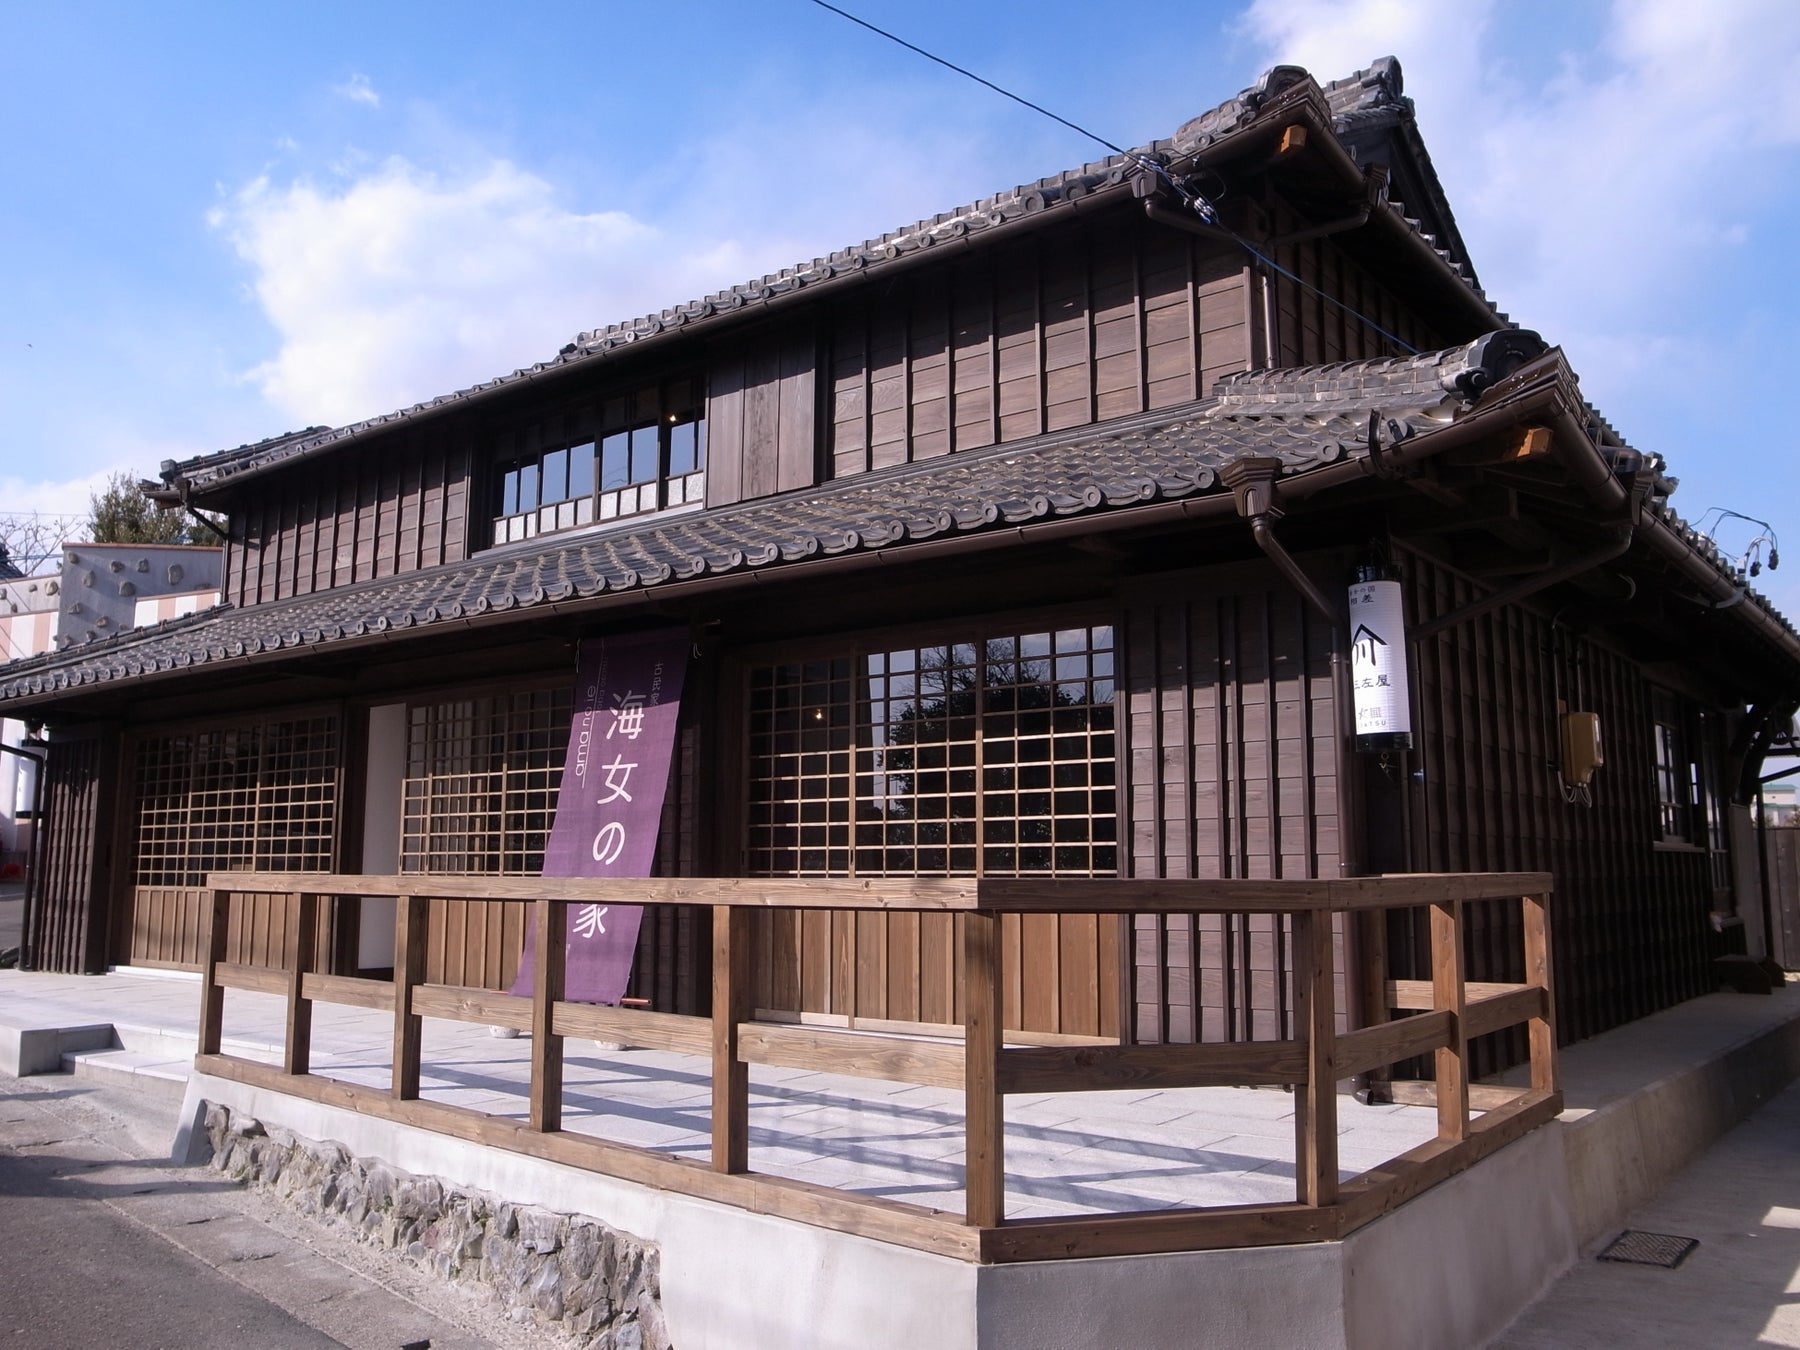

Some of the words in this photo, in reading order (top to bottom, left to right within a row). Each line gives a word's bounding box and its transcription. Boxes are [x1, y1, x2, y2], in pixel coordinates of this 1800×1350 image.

[584, 685, 596, 702] ie
[582, 707, 591, 726] no
[575, 731, 589, 776] ama
